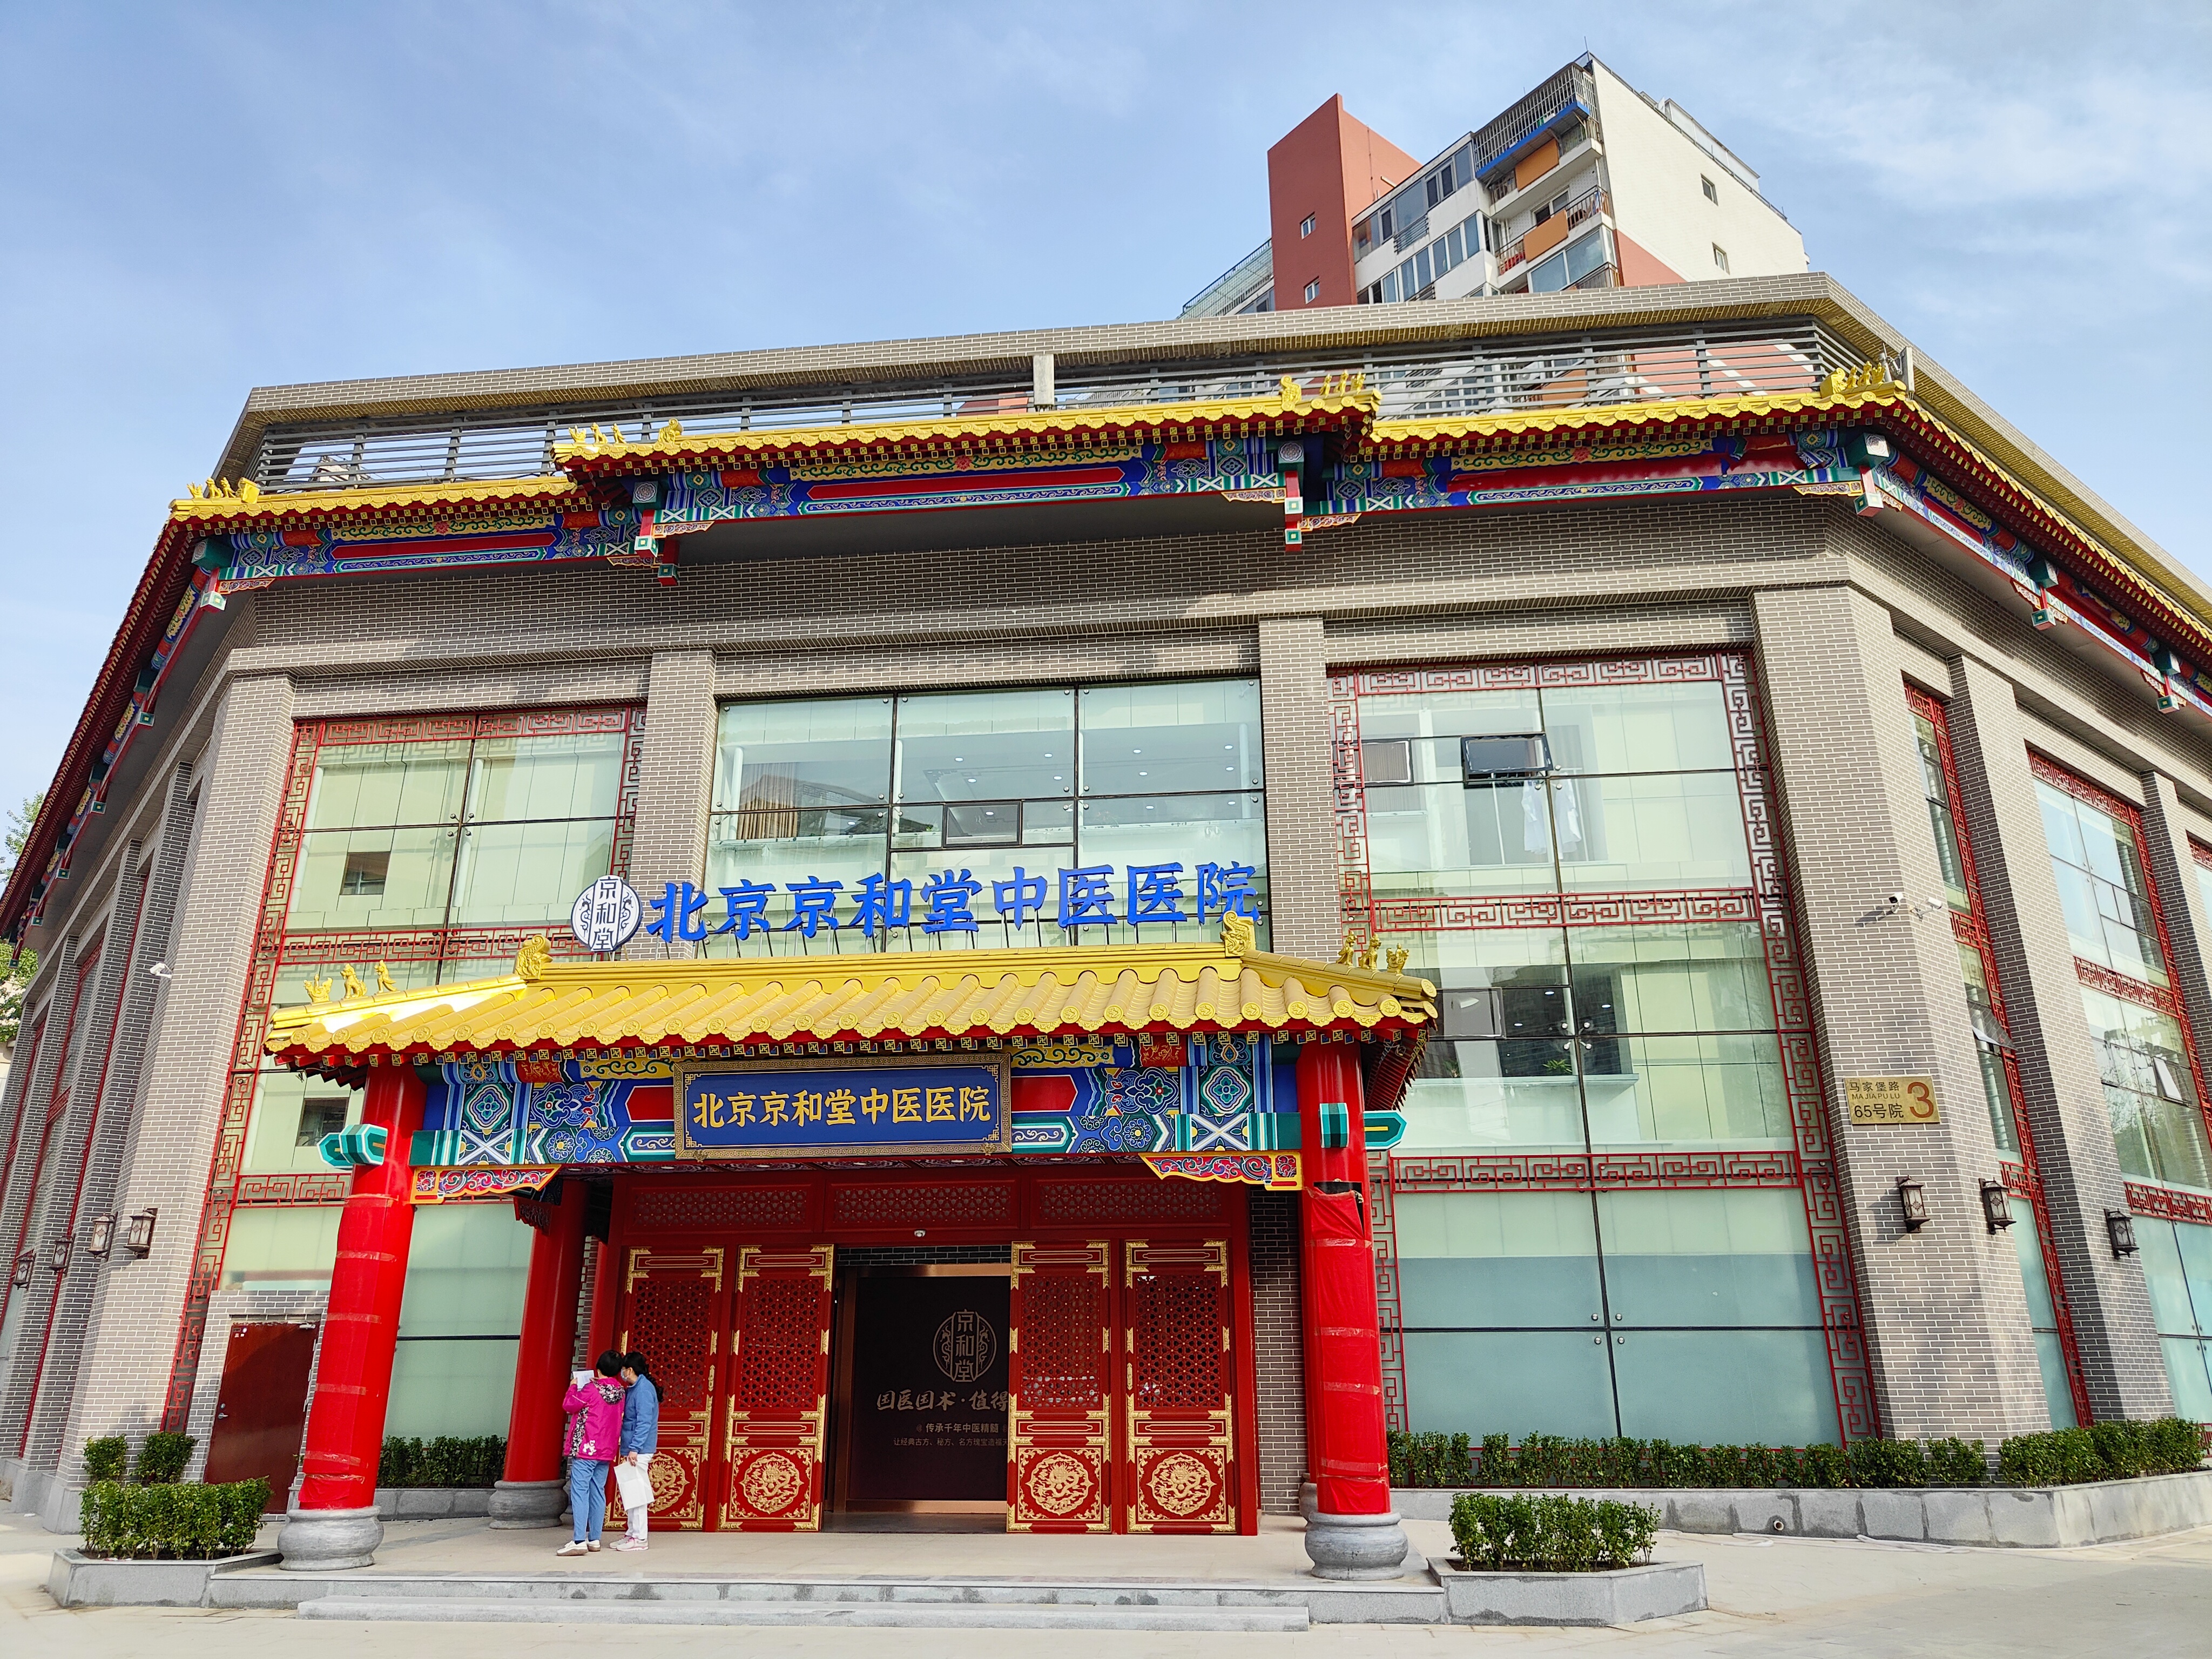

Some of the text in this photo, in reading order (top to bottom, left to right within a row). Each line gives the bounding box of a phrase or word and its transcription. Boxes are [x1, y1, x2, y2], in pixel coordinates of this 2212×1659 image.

[593, 876, 618, 950] 京和堂
[646, 861, 1260, 943] 北京京和堂中医医院
[1849, 1081, 1900, 1092] 马家堡路
[1907, 1082, 1934, 1118] 3
[693, 1085, 991, 1128] 北京京和堂中医医院
[1854, 1103, 1904, 1118] 65号院
[955, 1309, 975, 1382] 京和堂
[926, 1423, 999, 1433] 传承千年中医精髓
